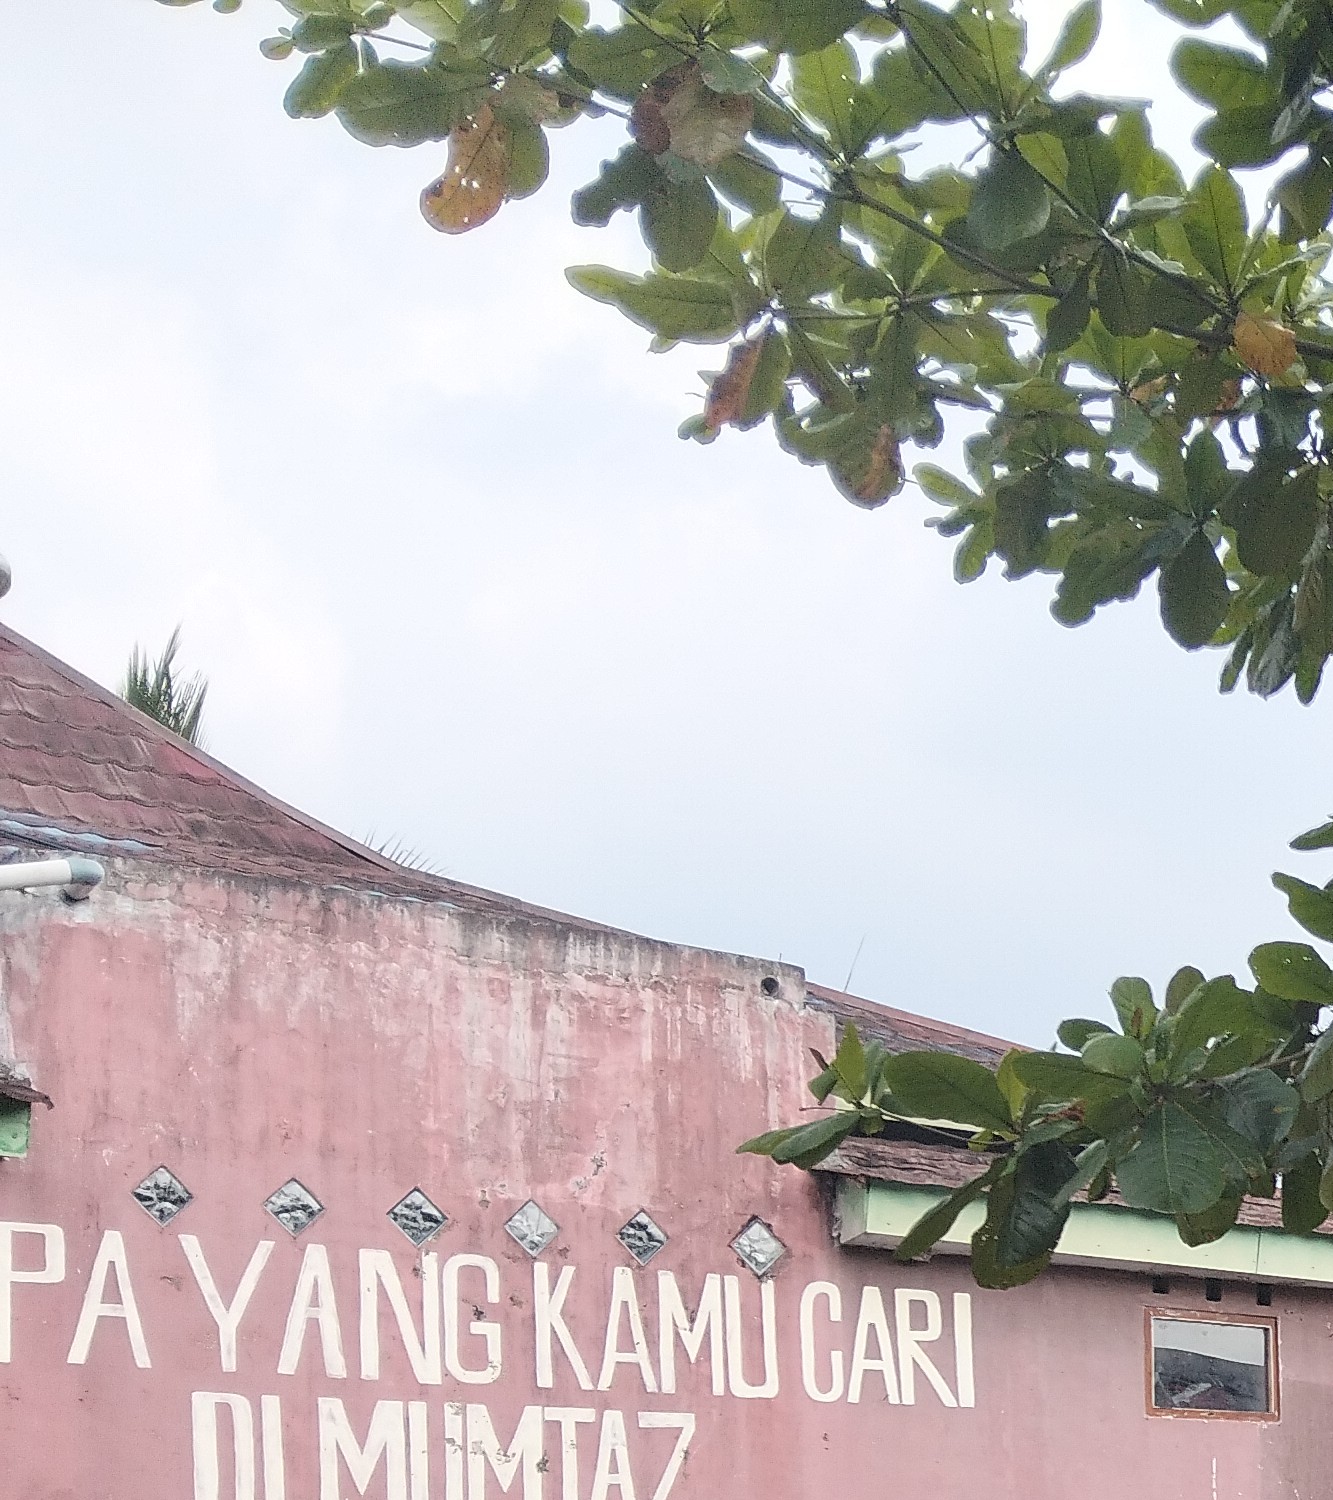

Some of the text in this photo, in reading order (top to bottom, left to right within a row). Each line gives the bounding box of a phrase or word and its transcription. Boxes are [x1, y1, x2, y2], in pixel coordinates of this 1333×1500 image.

[0, 1221, 976, 1408] PA YANG KAMU CARI
